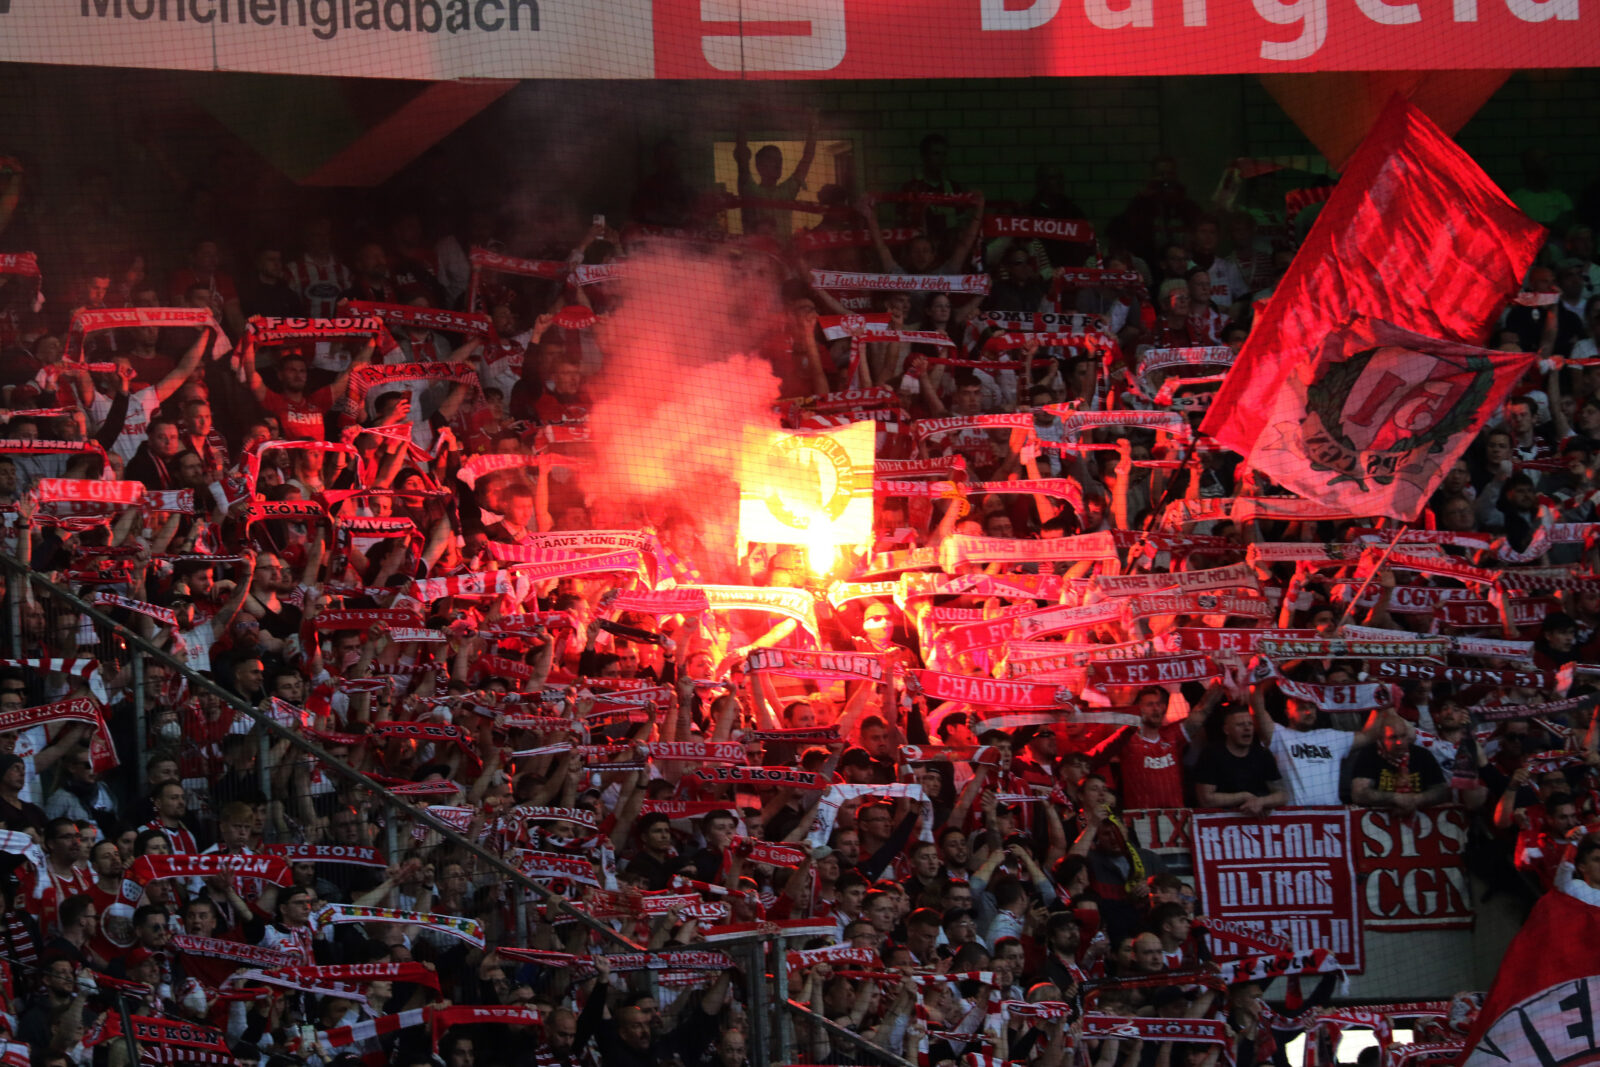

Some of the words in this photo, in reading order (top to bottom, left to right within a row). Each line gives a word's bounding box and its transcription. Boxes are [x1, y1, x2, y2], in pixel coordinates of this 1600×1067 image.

[1010, 217, 1030, 231] FC
[413, 311, 490, 331] KÖLN
[1041, 313, 1074, 326] ON
[287, 411, 324, 424] REWE
[41, 480, 83, 499] ME
[87, 480, 127, 499] ON
[268, 501, 327, 515] KÖLN
[314, 611, 412, 623] GERLING
[1464, 605, 1489, 624] FC
[1125, 664, 1150, 682] FC
[1156, 658, 1207, 681] KÖLN
[1379, 661, 1436, 679] SPS
[1444, 667, 1504, 686] CGN
[1514, 671, 1545, 688] 51
[936, 675, 1036, 705] CHAOTIX
[69, 699, 98, 716] KÖL
[648, 741, 708, 757] FSTIEG
[713, 744, 746, 759] 200
[716, 767, 744, 779] FC
[1200, 823, 1344, 861] RASCALS
[1360, 808, 1470, 858] SPS
[284, 844, 309, 856] FC
[187, 855, 216, 872] FC
[220, 854, 272, 874] KÖLN
[1217, 869, 1334, 907] ULTRAS
[1365, 866, 1472, 918] CGN
[316, 964, 342, 977] FC
[137, 1022, 160, 1037] FC
[165, 1024, 219, 1045] KÖLN
[1146, 1021, 1216, 1037] KÖLN
